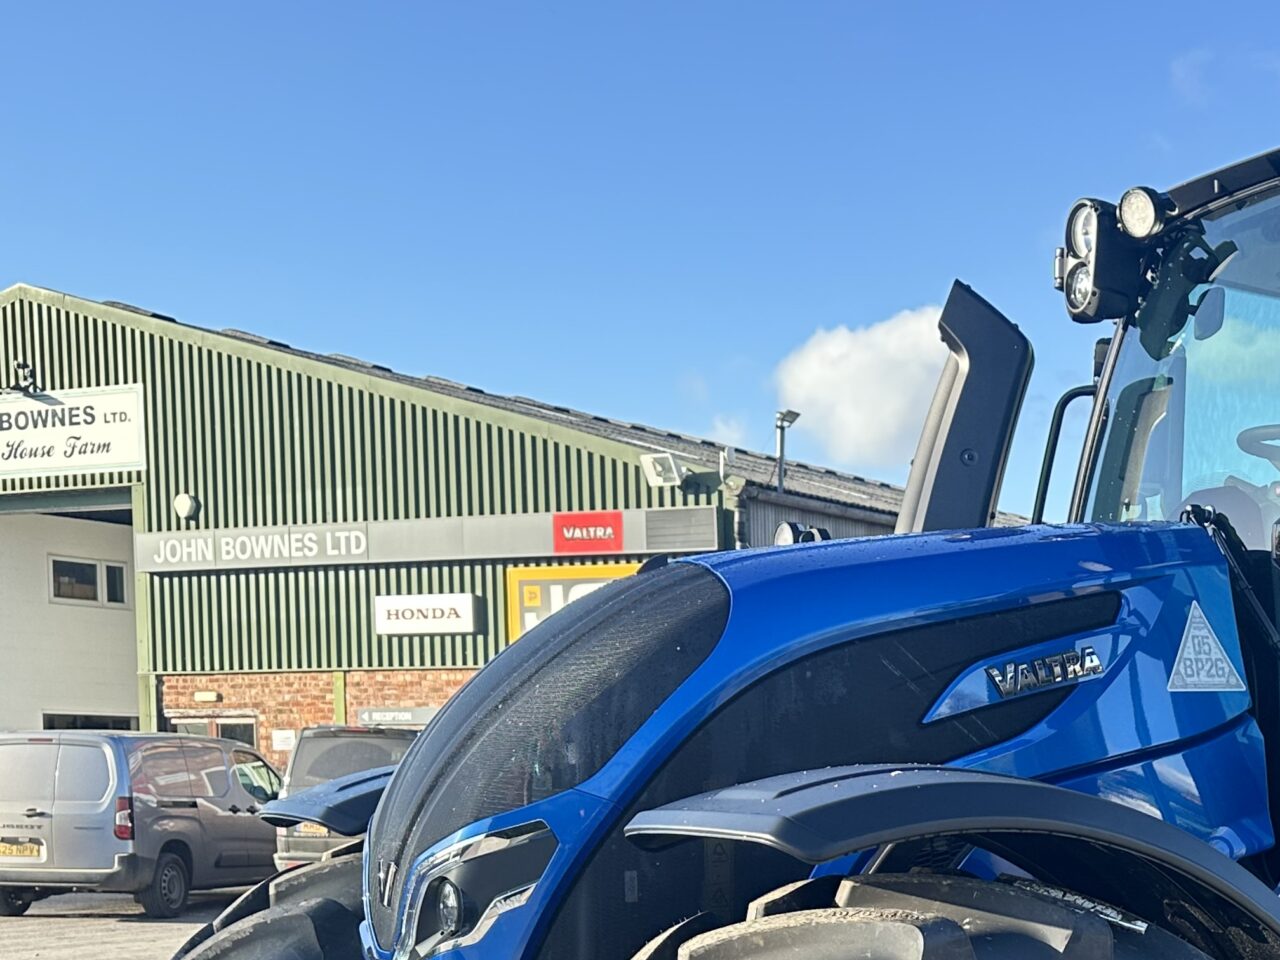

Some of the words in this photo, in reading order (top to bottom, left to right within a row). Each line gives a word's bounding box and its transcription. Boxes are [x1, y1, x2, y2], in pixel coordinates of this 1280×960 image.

[0, 405, 96, 431] BOWNES
[1, 439, 55, 460] House
[64, 435, 112, 458] Farm
[562, 526, 615, 541] VALTRA
[153, 537, 213, 564] JOHN
[221, 532, 318, 560] BOWNES
[326, 530, 367, 556] LTD
[386, 607, 461, 621] HONDA
[984, 645, 1105, 698] VALTRA
